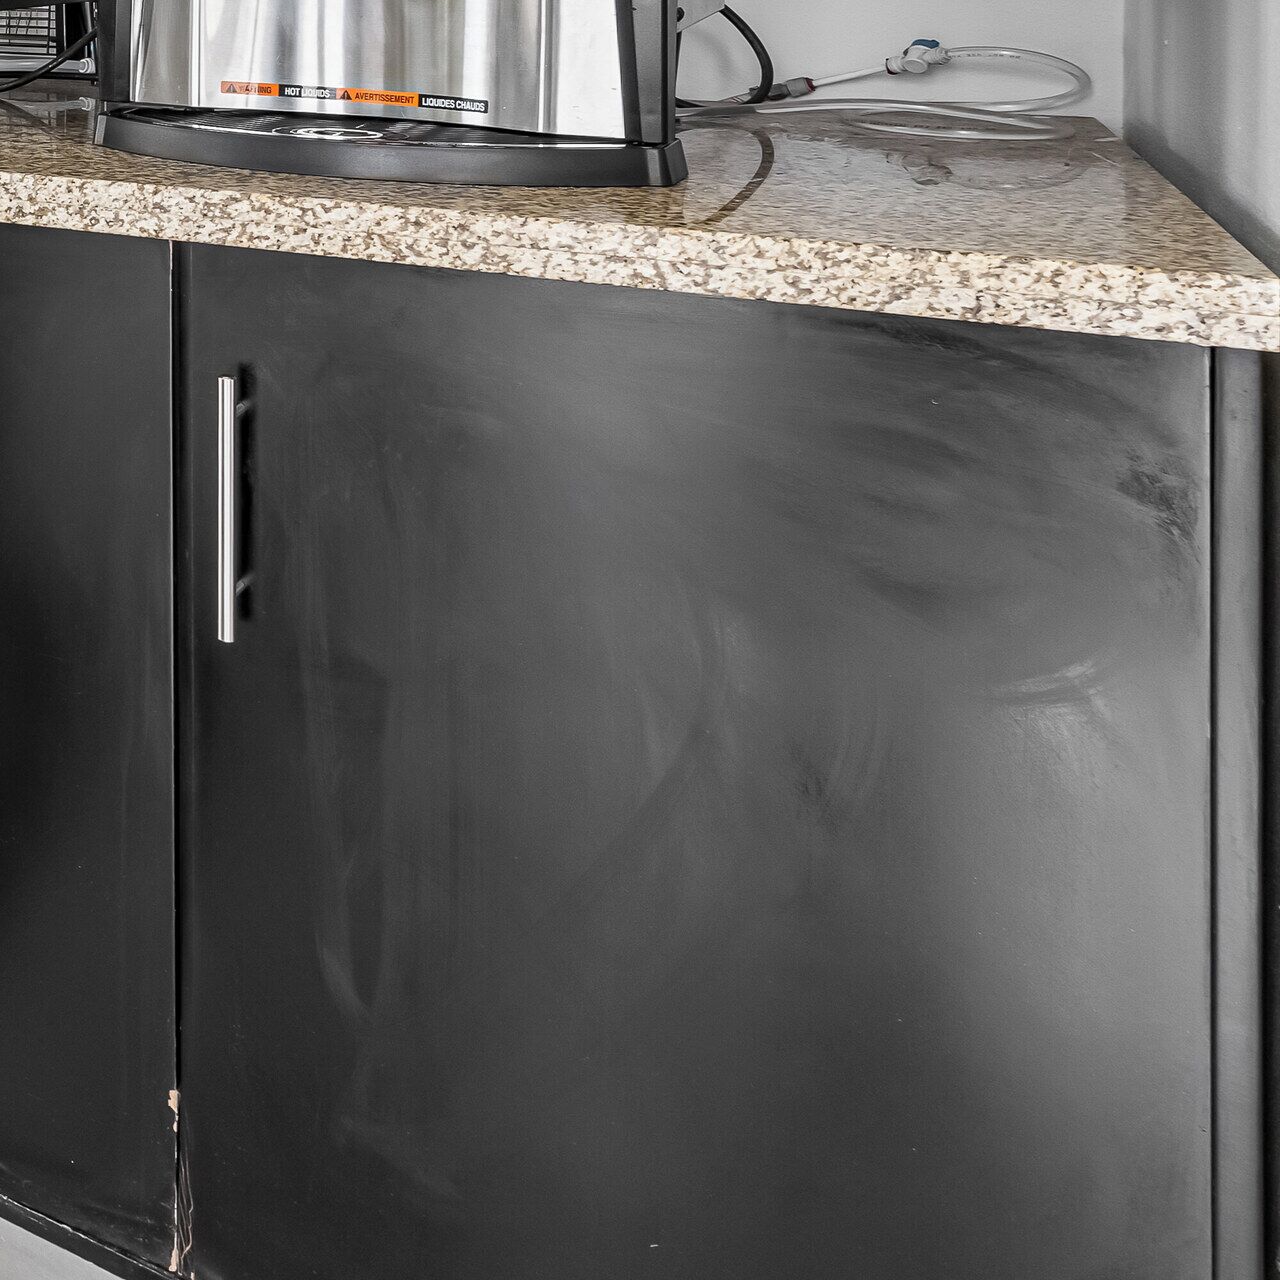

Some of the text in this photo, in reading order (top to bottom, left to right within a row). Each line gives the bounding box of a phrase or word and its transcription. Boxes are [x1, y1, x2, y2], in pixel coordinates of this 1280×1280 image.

[284, 87, 301, 96] HOT
[301, 88, 331, 98] LIQUIDS
[354, 92, 415, 104] AVERTISSEMENT
[421, 97, 455, 109] LIQUIDES
[455, 100, 486, 111] CHAUDS
